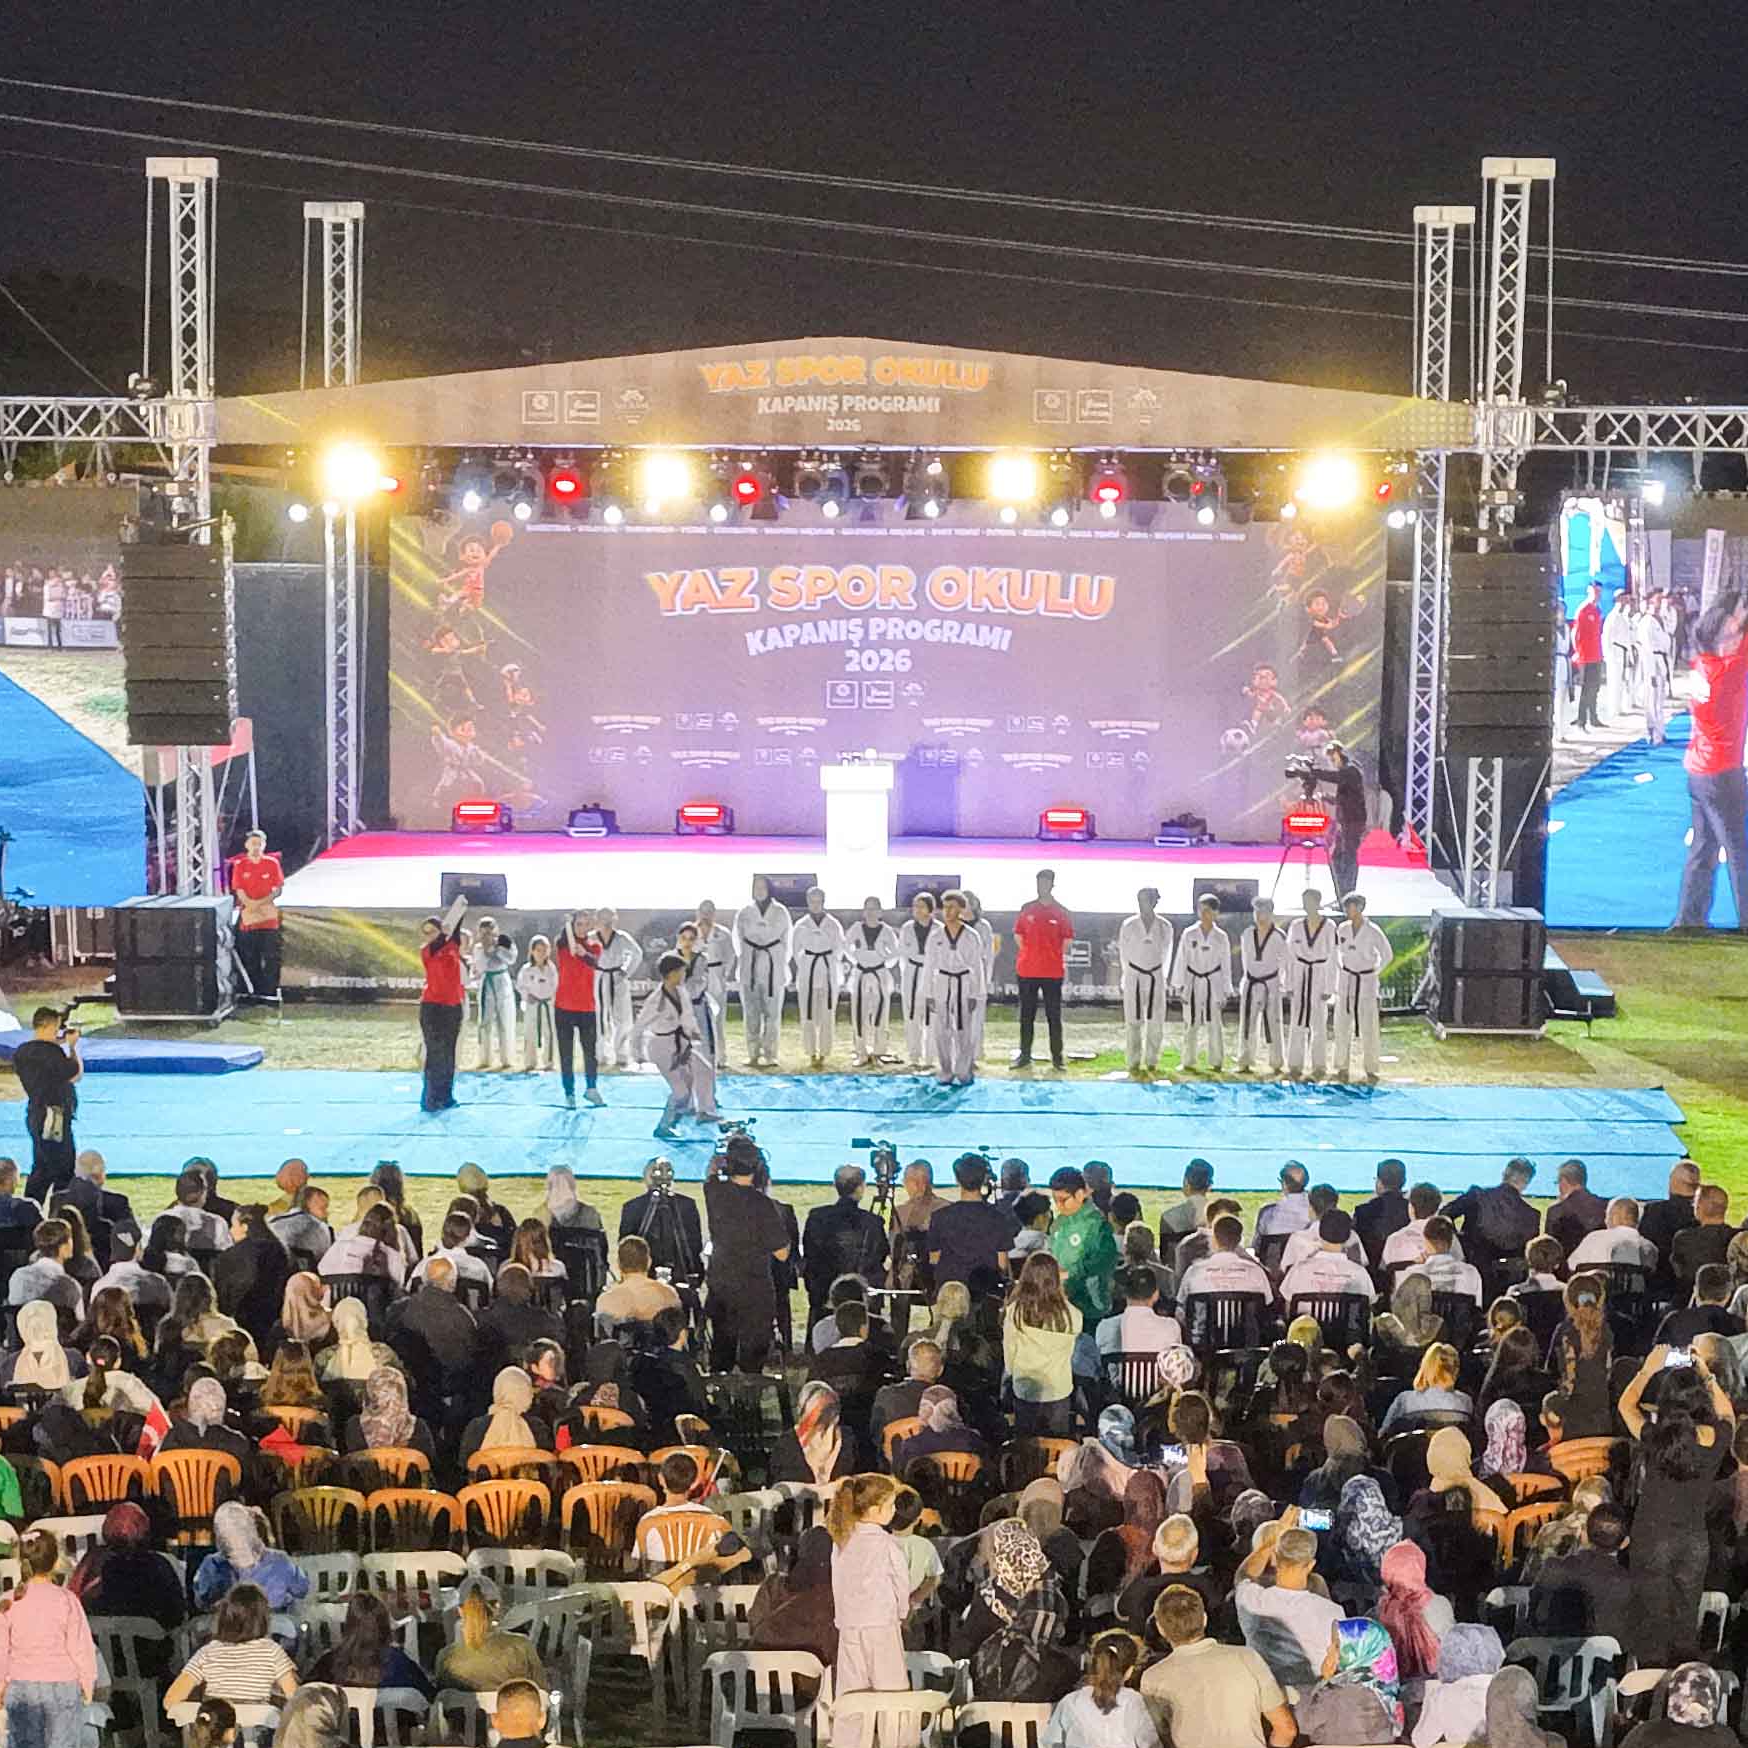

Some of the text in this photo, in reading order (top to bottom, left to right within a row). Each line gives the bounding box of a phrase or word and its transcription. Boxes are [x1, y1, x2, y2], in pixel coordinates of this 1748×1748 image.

[700, 356, 992, 392] YAZ SPOR OKULU
[758, 396, 941, 416] KAPANIŞ PROGRAMI
[827, 419, 861, 432] 2026
[647, 565, 1117, 620] YAZ SPOR OKULU
[745, 618, 1013, 656] KAPANIŞ PROGRAMI
[845, 649, 913, 672] 2026
